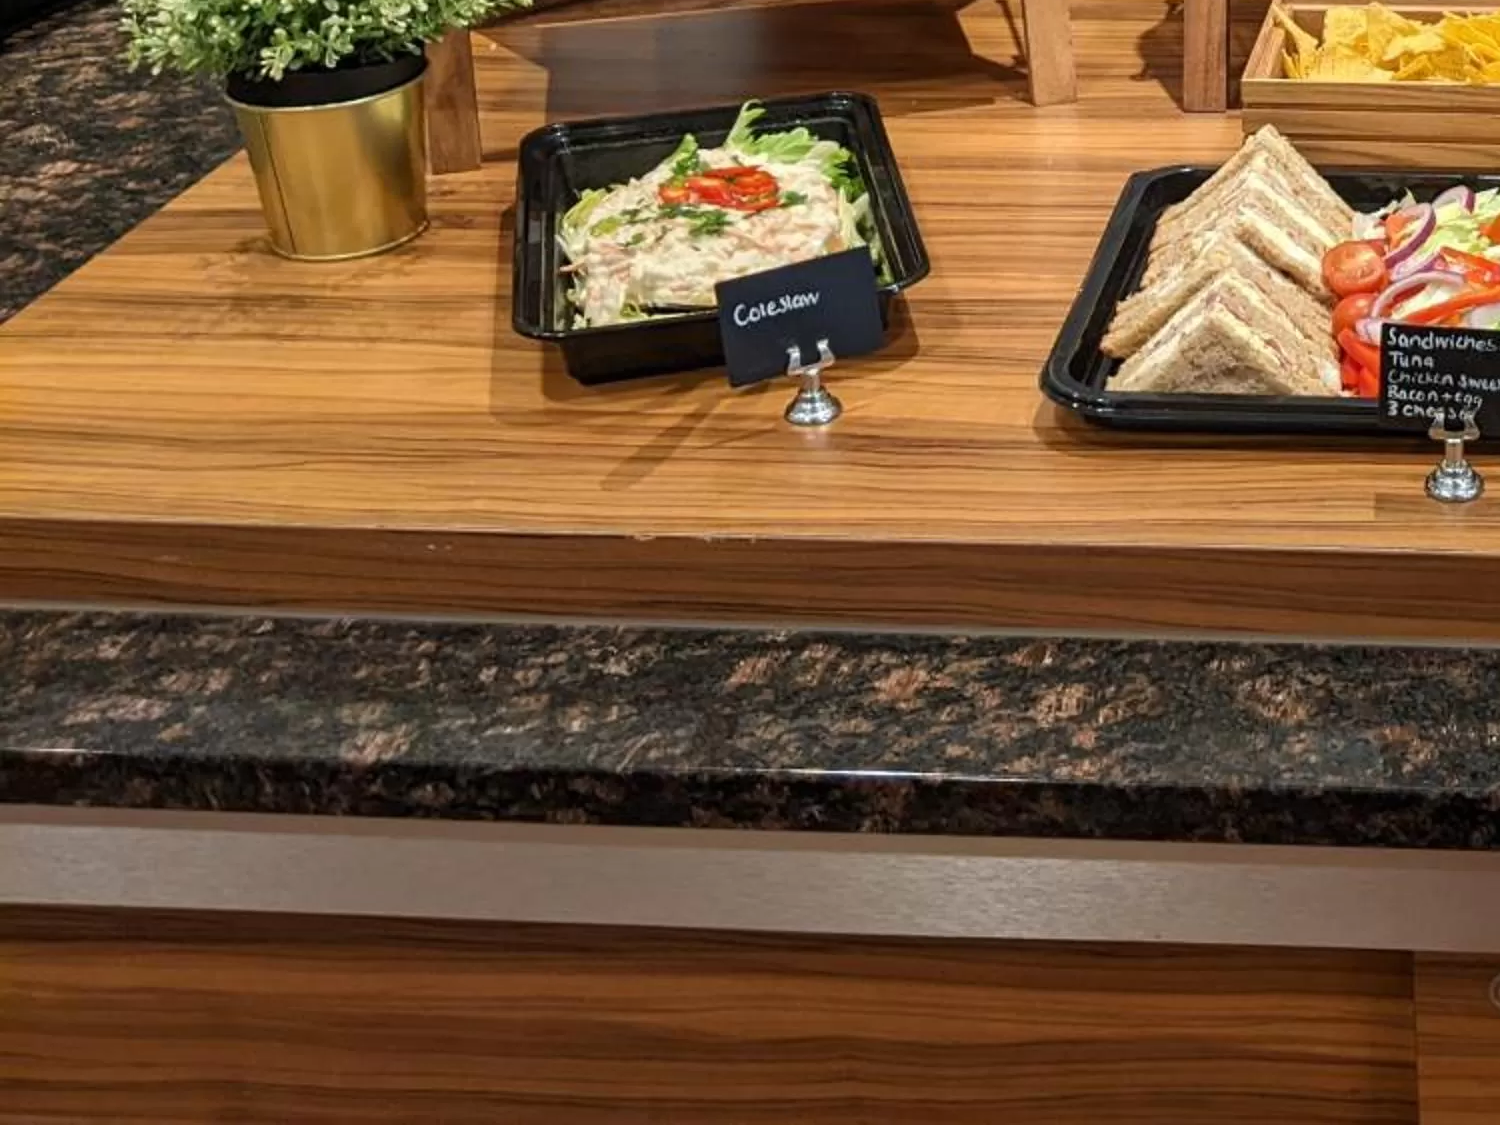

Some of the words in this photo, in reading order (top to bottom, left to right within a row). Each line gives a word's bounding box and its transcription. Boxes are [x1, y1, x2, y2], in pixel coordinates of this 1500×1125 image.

[733, 291, 820, 326] Coleslaw
[1388, 350, 1434, 368] Tuna
[1387, 385, 1439, 402] Bacon
[1387, 400, 1398, 416] 3
